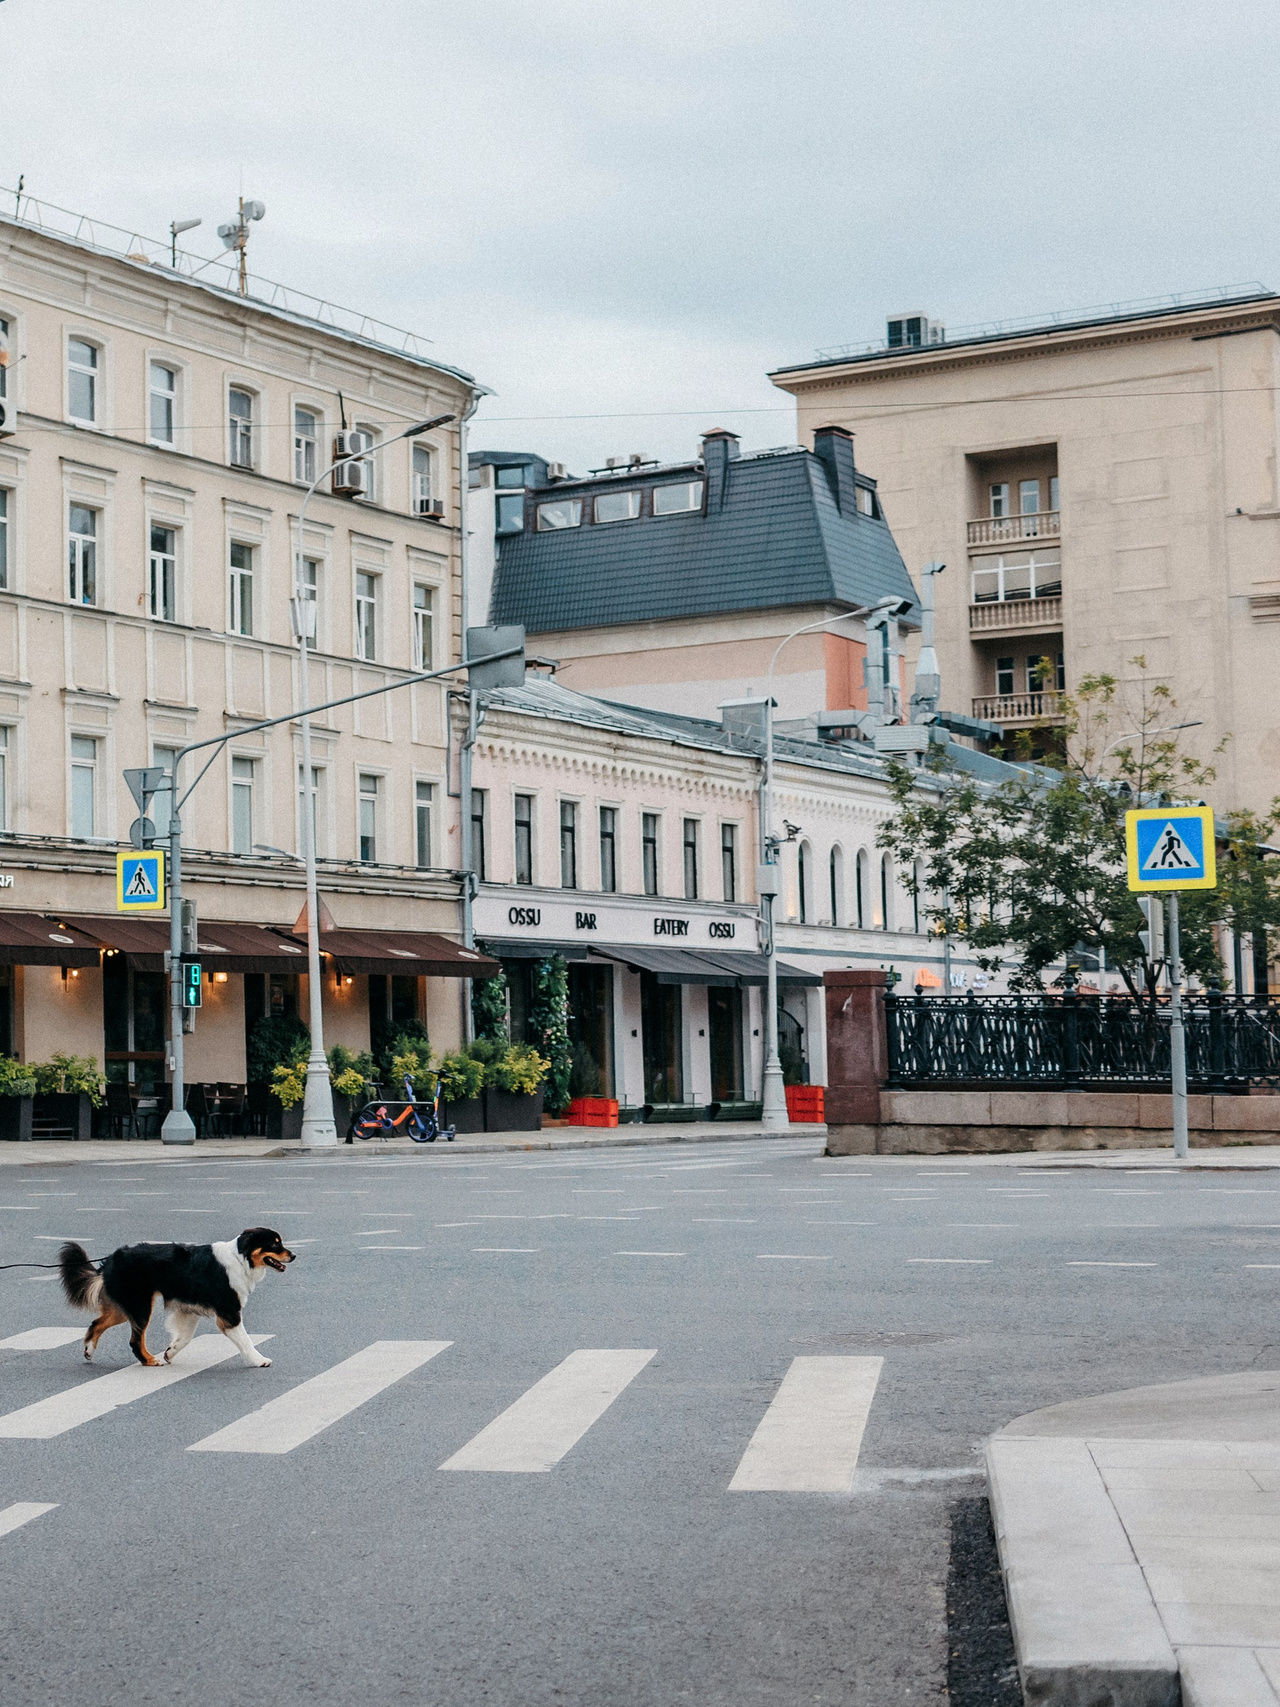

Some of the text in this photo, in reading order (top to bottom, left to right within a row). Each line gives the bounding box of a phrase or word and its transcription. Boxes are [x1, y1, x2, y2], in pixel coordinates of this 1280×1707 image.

[508, 906, 735, 938] OSSU BAR EATERY OSSU
[191, 965, 200, 986] 8
